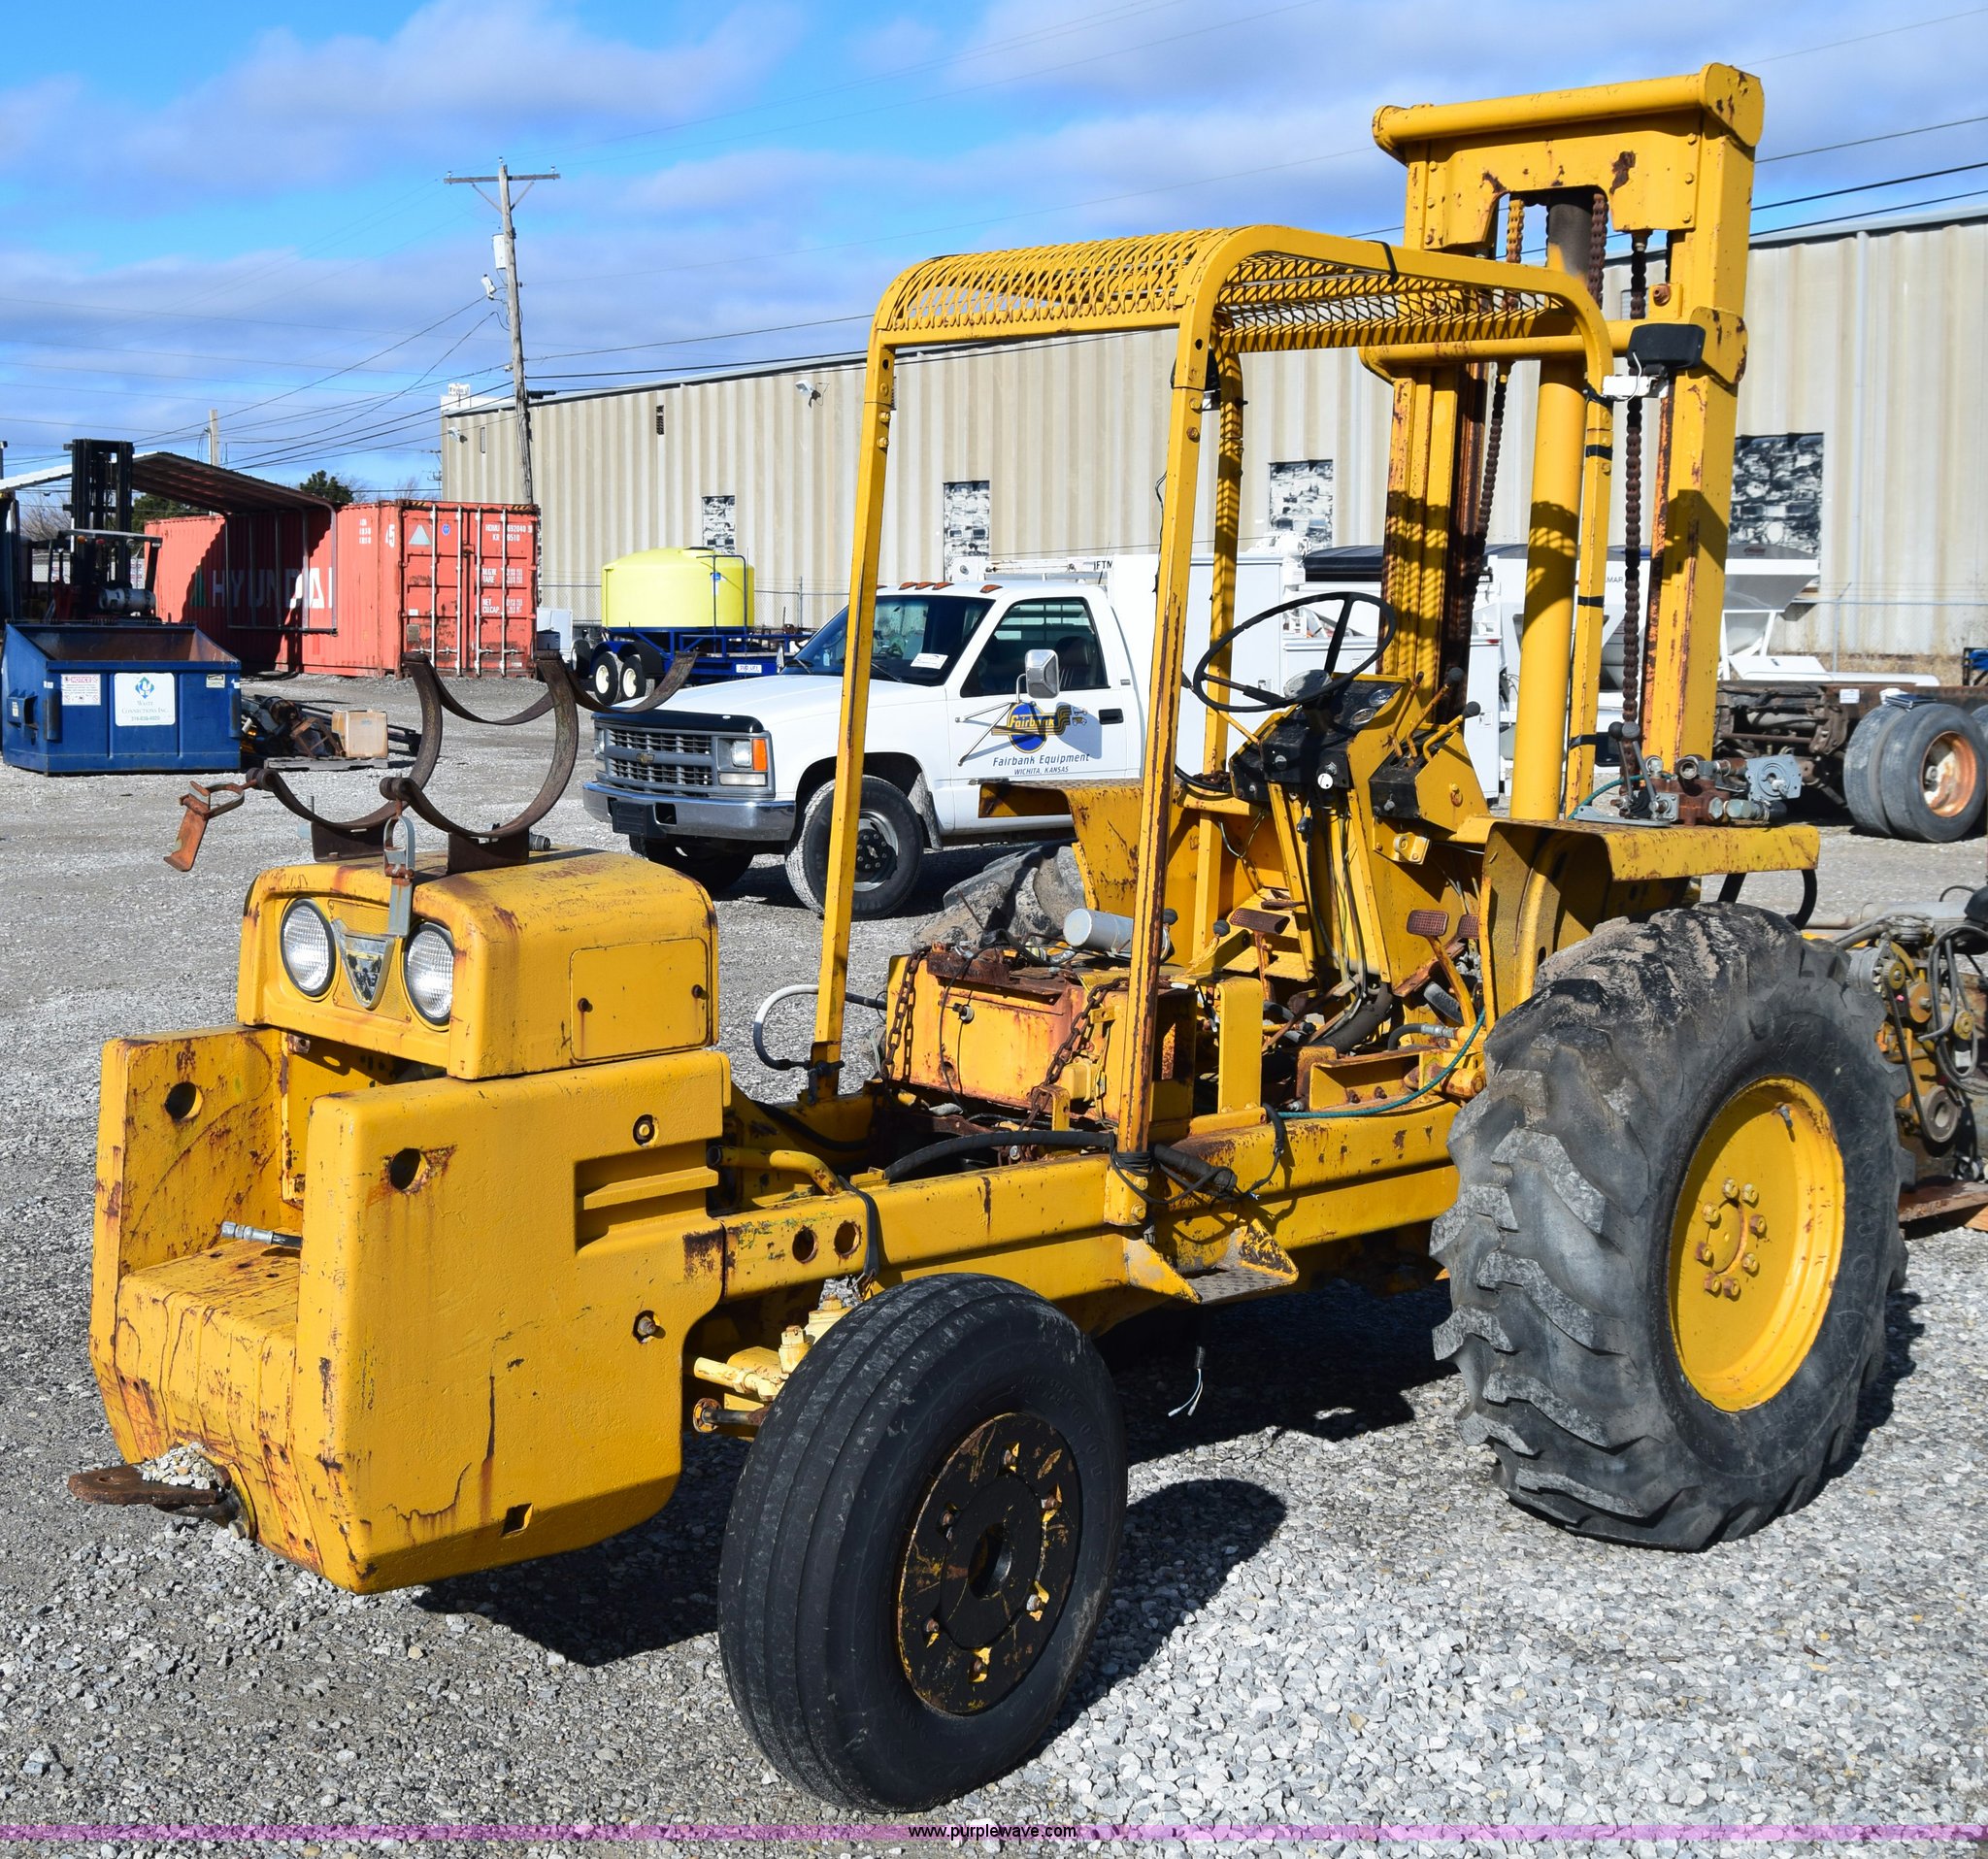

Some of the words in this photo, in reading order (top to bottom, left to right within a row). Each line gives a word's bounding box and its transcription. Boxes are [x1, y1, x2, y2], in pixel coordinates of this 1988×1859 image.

[213, 567, 333, 609] HYUNDAI
[1010, 714, 1055, 728] Fairbank
[993, 755, 1036, 767] Fairbank
[1039, 753, 1090, 765] Equipment
[1014, 767, 1042, 776] WICHITA,
